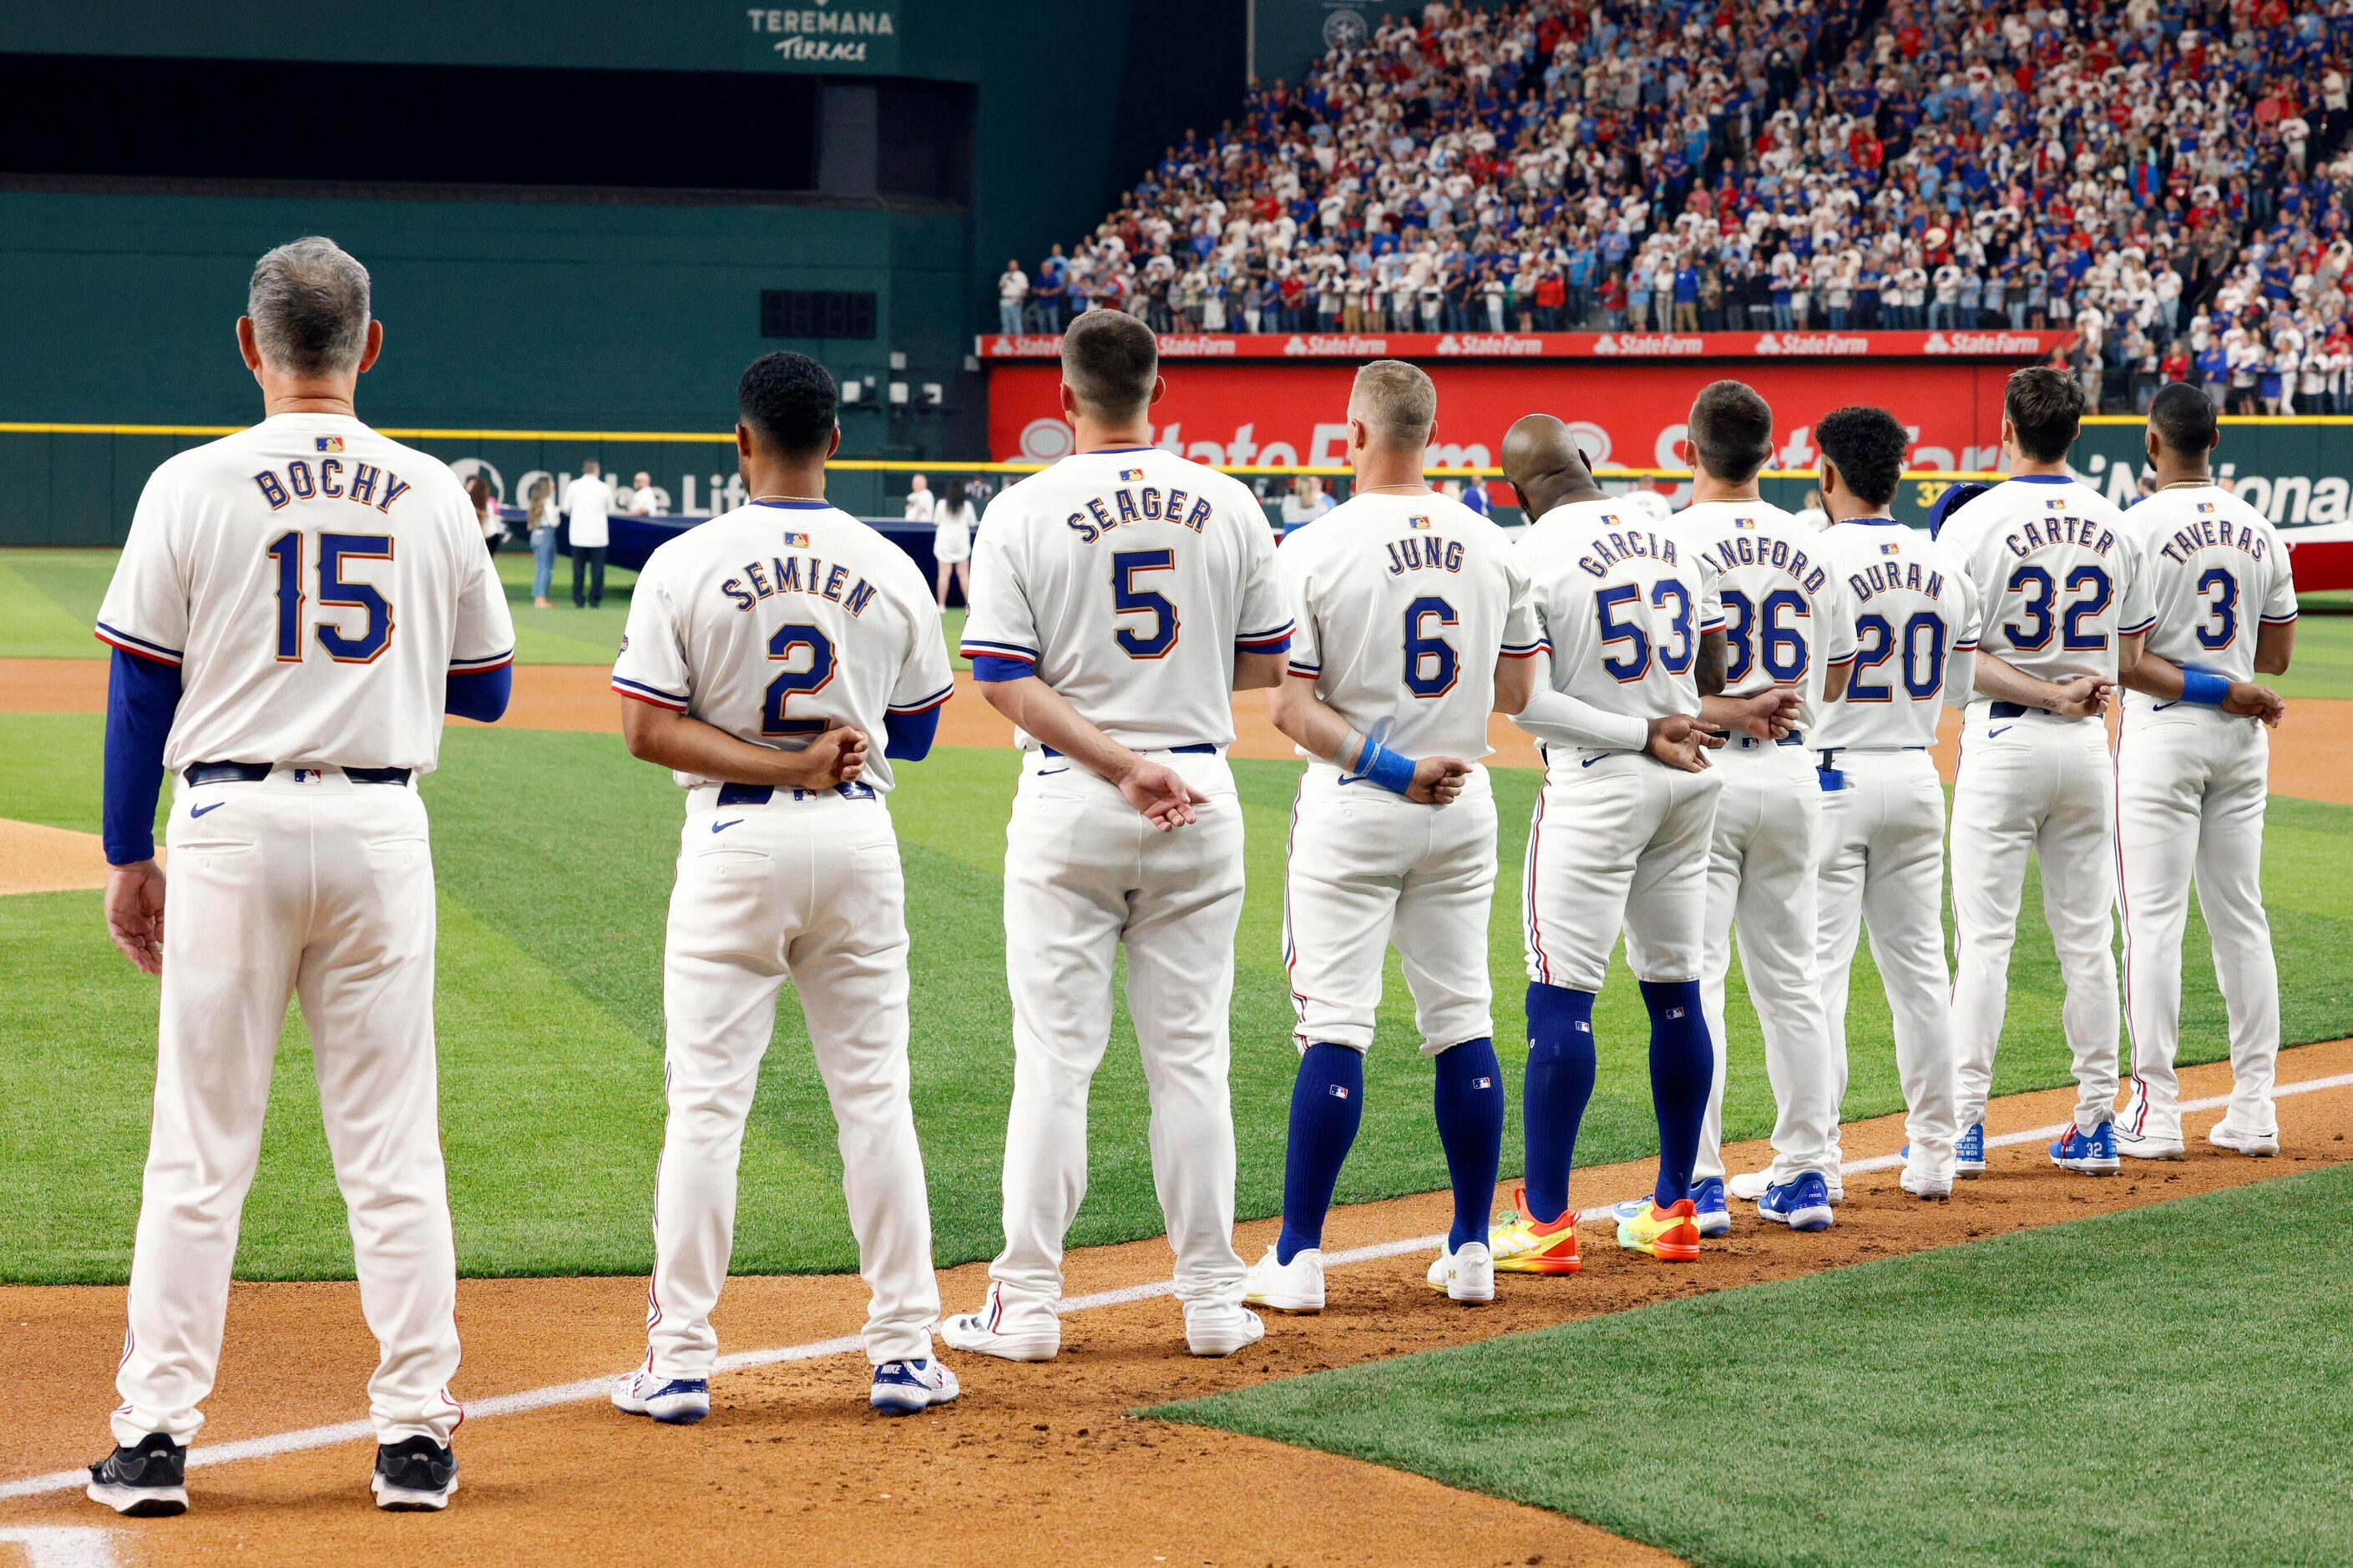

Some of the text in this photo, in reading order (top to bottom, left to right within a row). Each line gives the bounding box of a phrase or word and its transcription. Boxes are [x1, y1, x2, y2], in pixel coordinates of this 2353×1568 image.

[747, 9, 894, 35] TEREMANA
[252, 459, 412, 513] BOCHY
[683, 473, 749, 517] Lif
[1067, 488, 1212, 544] SEAGER
[2006, 517, 2115, 559] CARTER
[2159, 520, 2267, 566] TAVERAS
[1386, 536, 1465, 576] JUNG
[1579, 531, 1677, 579] GARCIA
[1848, 561, 1945, 604] DURAN
[266, 530, 395, 664] 15
[721, 557, 877, 618] SEMIEN
[1110, 548, 1181, 660] 5
[2003, 564, 2114, 651] 32
[2195, 565, 2239, 651] 3
[1401, 594, 1460, 699] 6
[1594, 579, 1695, 684] 53
[1846, 610, 1947, 702] 20
[761, 623, 838, 736] 2
[2087, 1141, 2103, 1157] 32
[881, 1364, 902, 1374] NIKE
